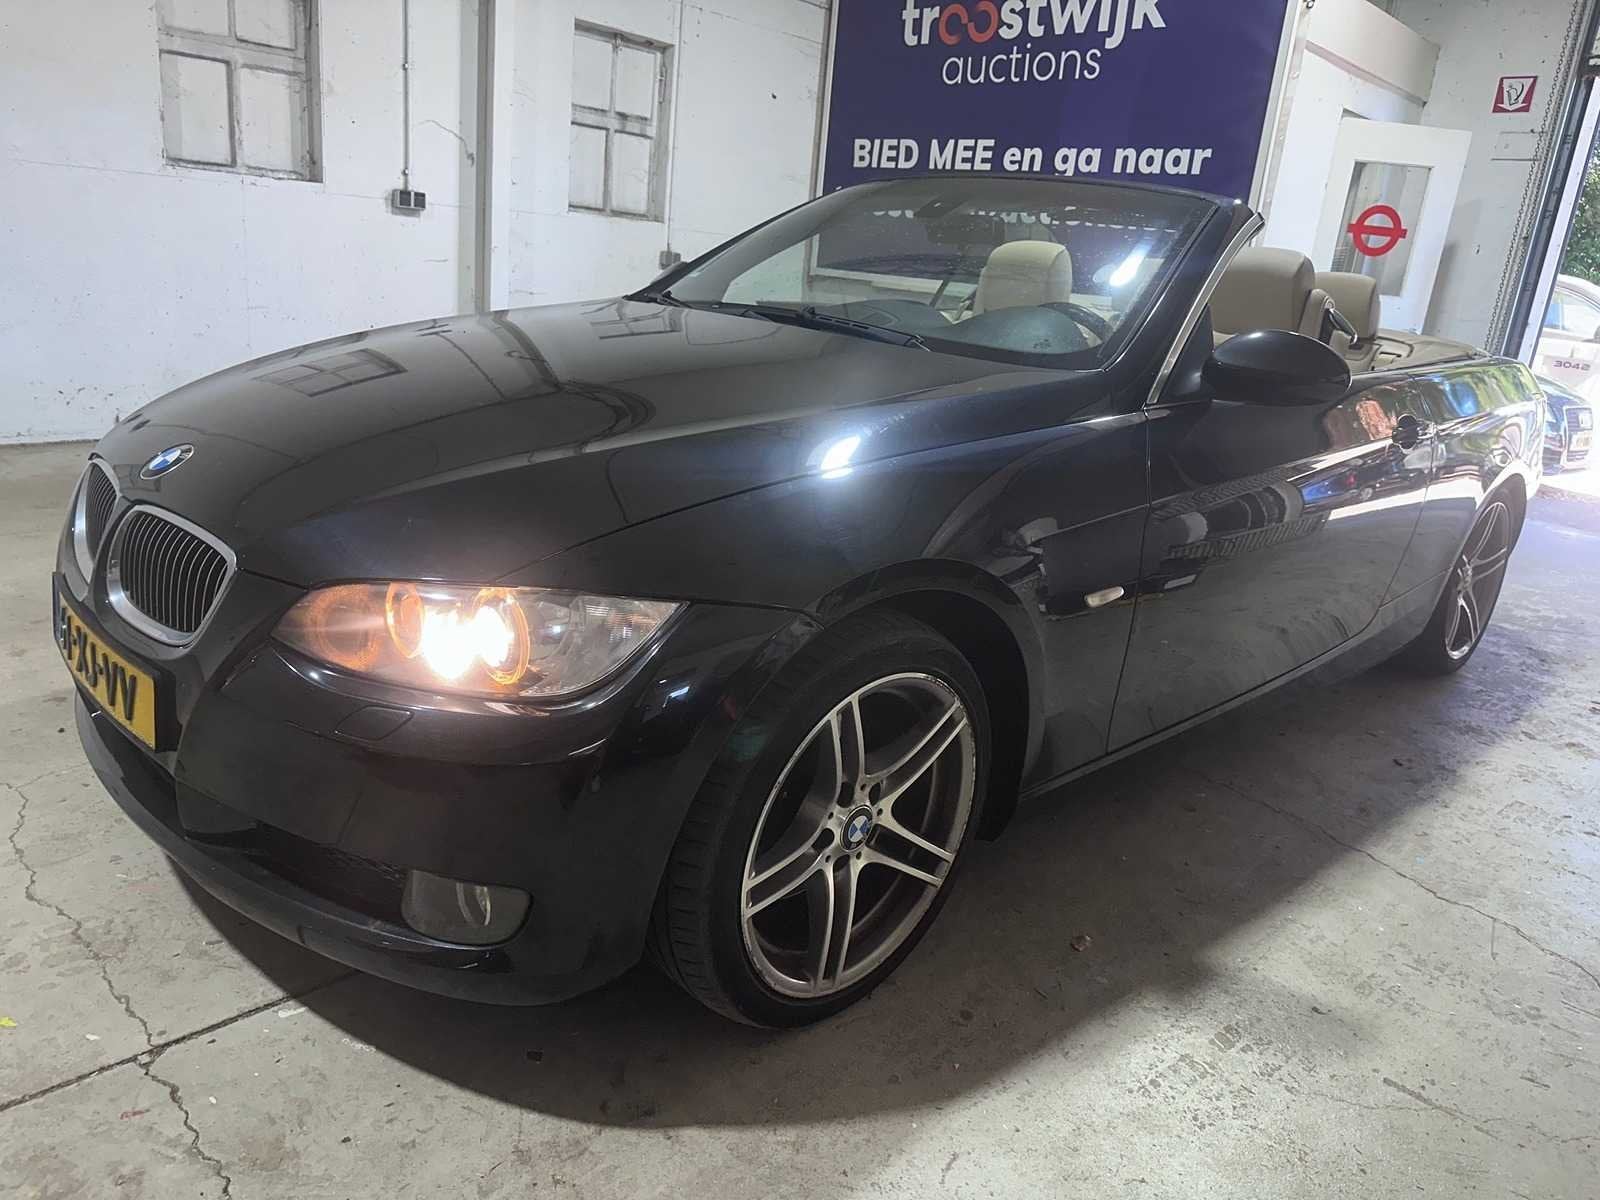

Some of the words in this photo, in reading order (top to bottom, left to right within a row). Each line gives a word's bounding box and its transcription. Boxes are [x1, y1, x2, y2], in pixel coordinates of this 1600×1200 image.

[902, 0, 1167, 49] troostwijk
[942, 43, 1102, 84] auctions
[853, 139, 919, 169] BIED
[928, 139, 995, 171] MEE
[1003, 146, 1042, 172] en
[1055, 148, 1102, 176] ga
[1112, 147, 1212, 175] naar
